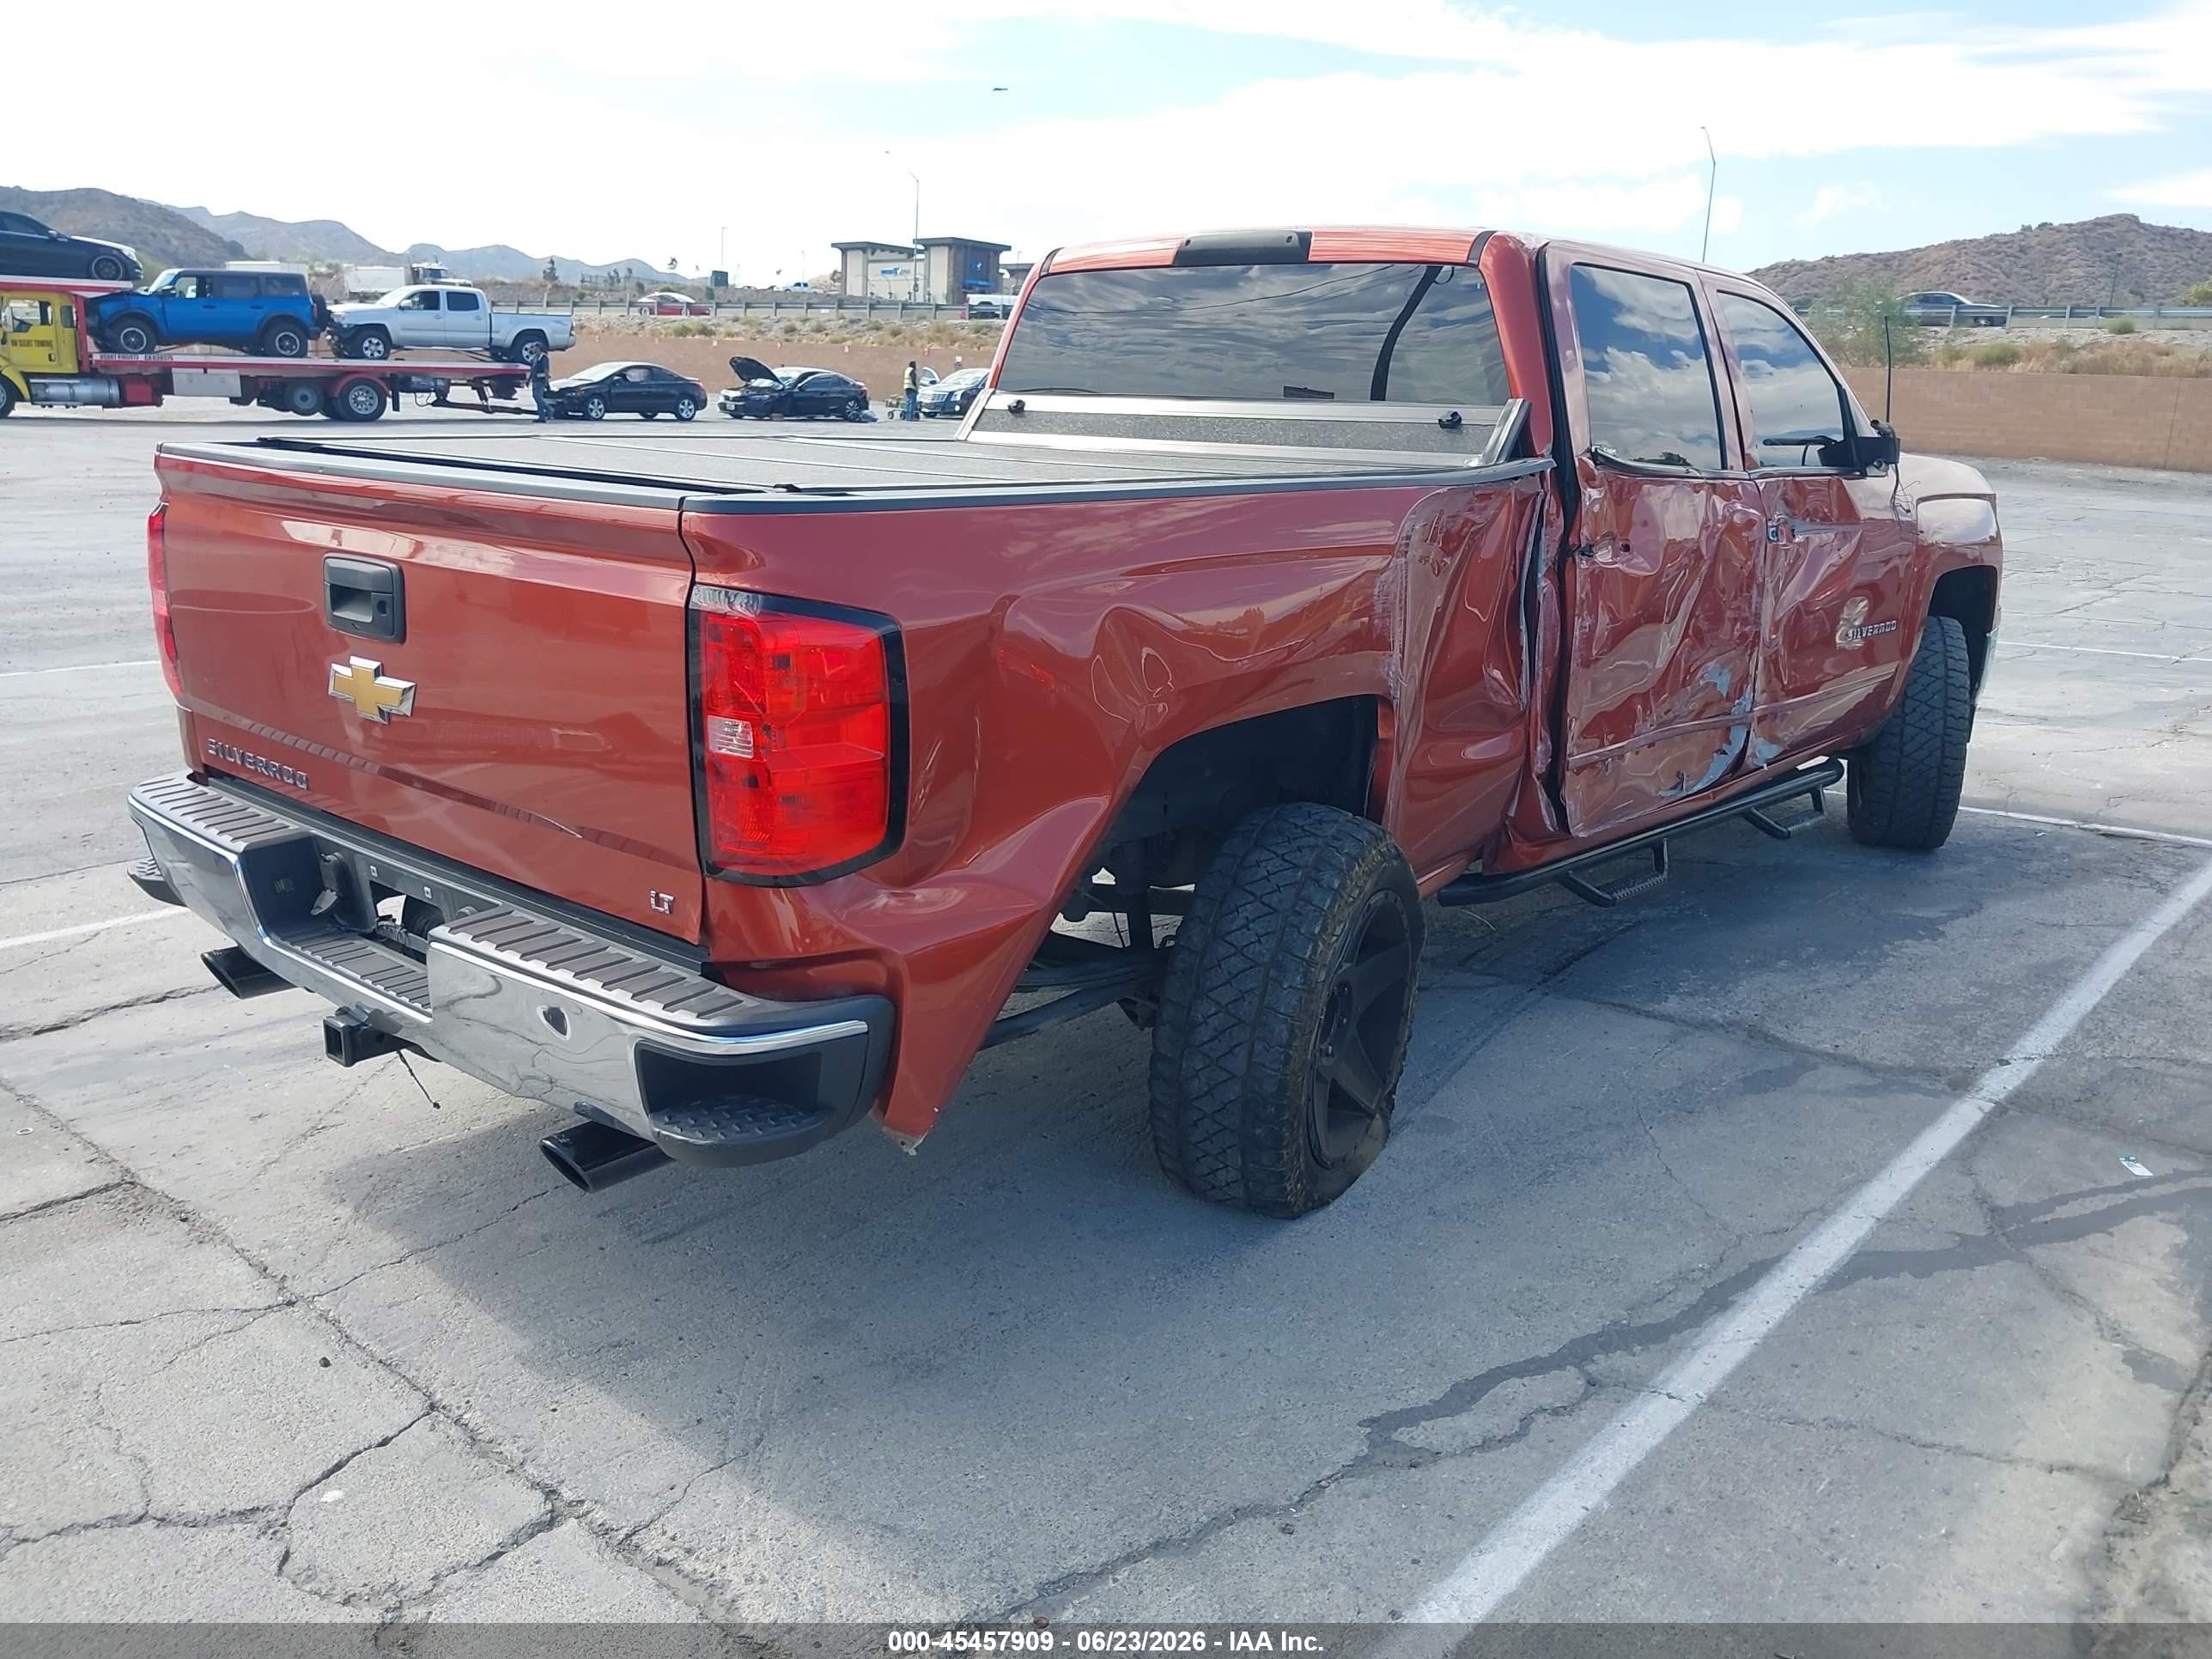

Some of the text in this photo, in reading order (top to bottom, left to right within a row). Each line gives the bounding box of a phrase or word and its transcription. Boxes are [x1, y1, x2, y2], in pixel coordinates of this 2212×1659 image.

[1847, 620, 1897, 641] SILVERADO
[208, 738, 309, 790] SILVERADO
[650, 890, 674, 914] LT
